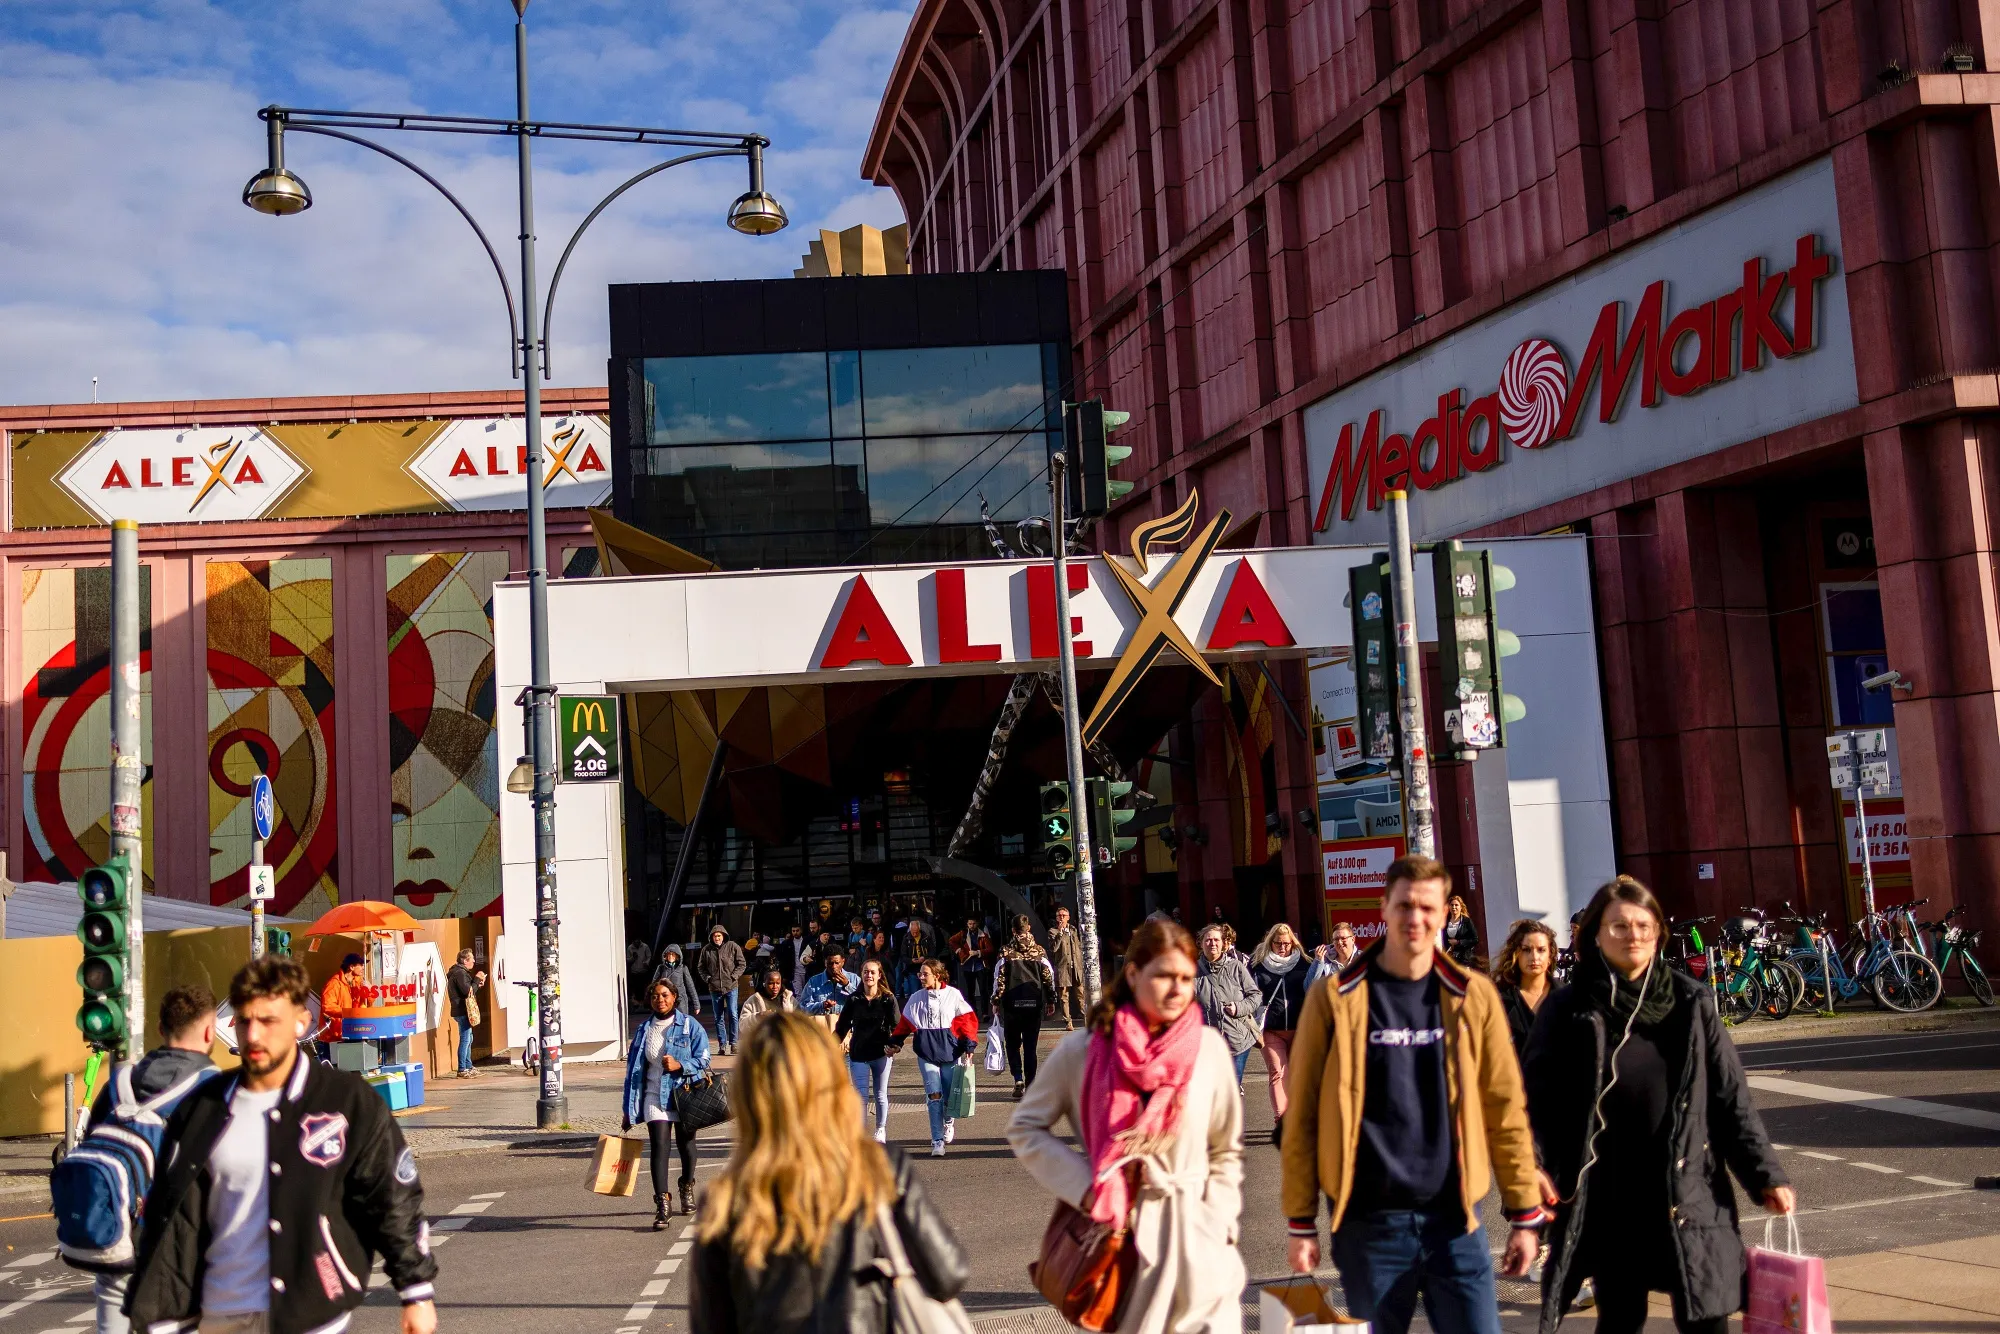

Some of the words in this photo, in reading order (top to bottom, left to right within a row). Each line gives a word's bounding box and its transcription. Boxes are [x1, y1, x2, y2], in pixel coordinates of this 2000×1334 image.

[101, 435, 264, 513] ALEXA
[820, 487, 1297, 749] ALEXA
[1322, 687, 1344, 699] Connect
[1376, 816, 1394, 828] AMD
[1883, 842, 1899, 855] 36
[1328, 859, 1338, 869] Auf
[1339, 857, 1356, 869] 8.000
[1357, 858, 1367, 869] qm
[893, 873, 931, 882] EINGANG
[1329, 874, 1339, 885] mit
[1340, 873, 1347, 884] 36
